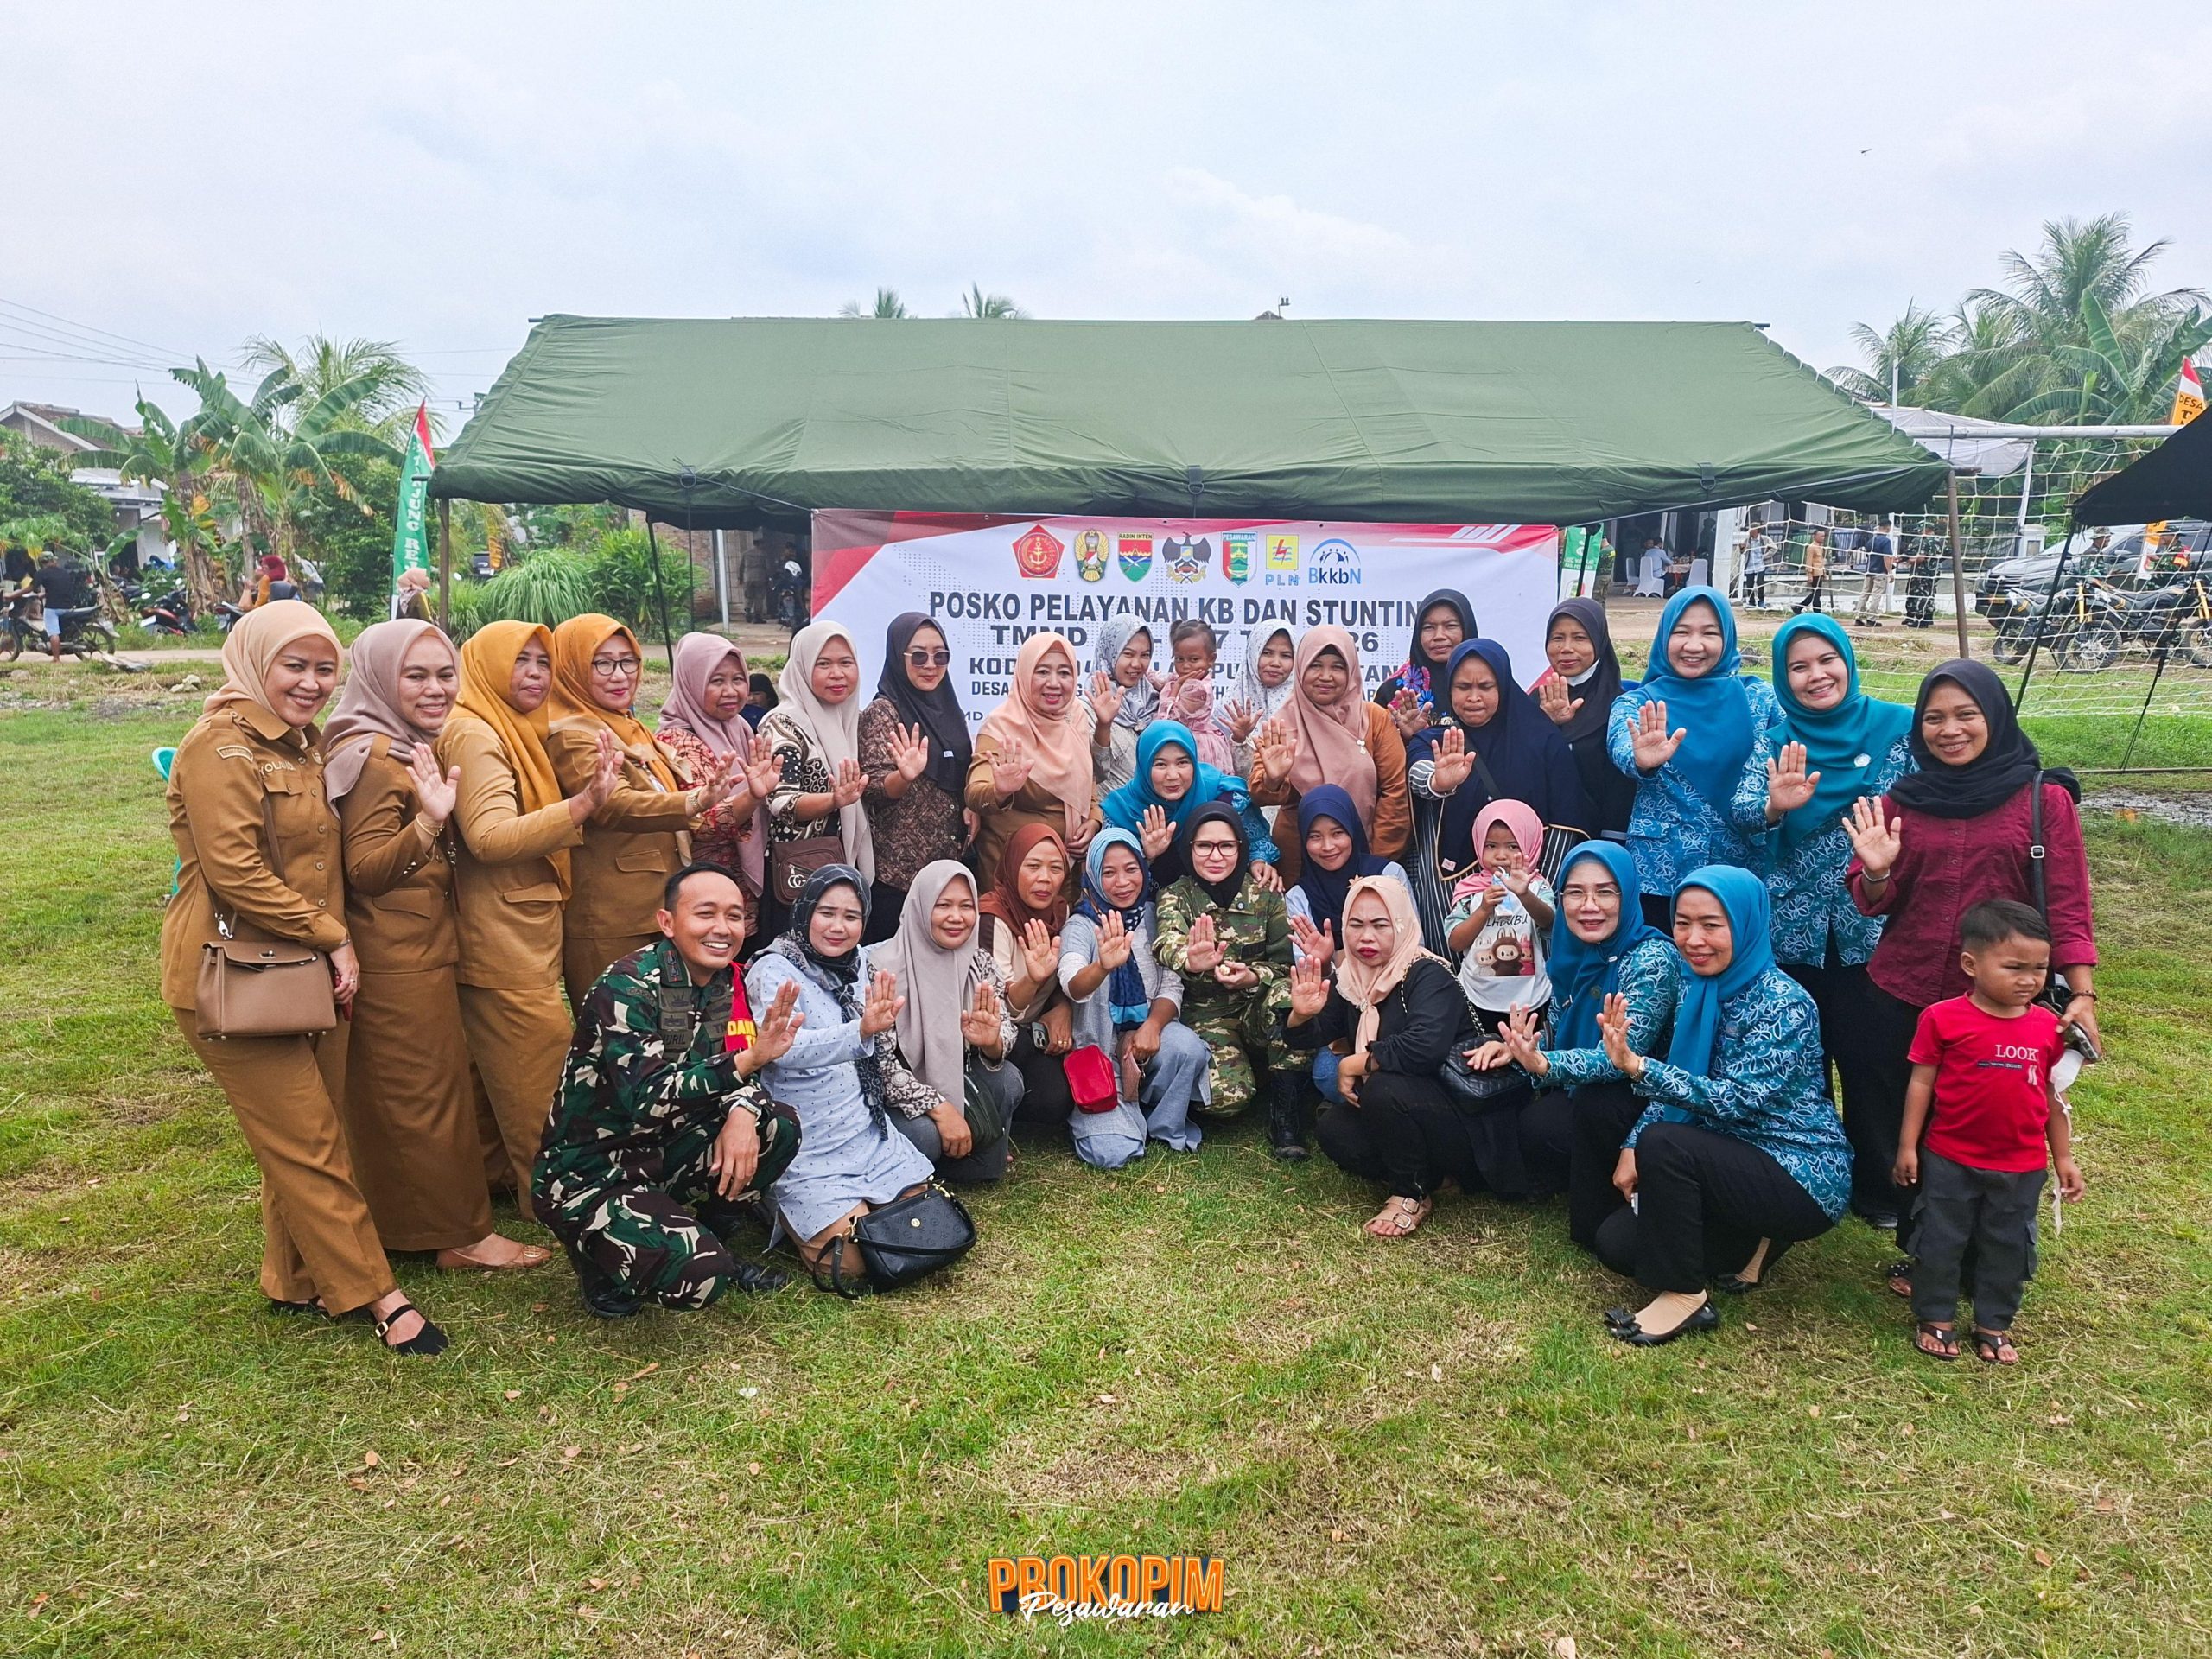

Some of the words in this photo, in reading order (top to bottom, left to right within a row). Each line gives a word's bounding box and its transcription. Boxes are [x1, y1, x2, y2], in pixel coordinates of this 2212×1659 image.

[2179, 394, 2203, 410] DESA
[404, 537, 420, 569] REJ
[930, 591, 1020, 620] POSKO
[1198, 597, 1234, 625] KB
[1243, 598, 1296, 625] DAN
[1306, 600, 1419, 627] STUNTIN
[969, 658, 1015, 675] KOD
[972, 681, 1009, 696] DESA
[664, 1033, 686, 1045] URIL
[1994, 1044, 2039, 1062] LOOK
